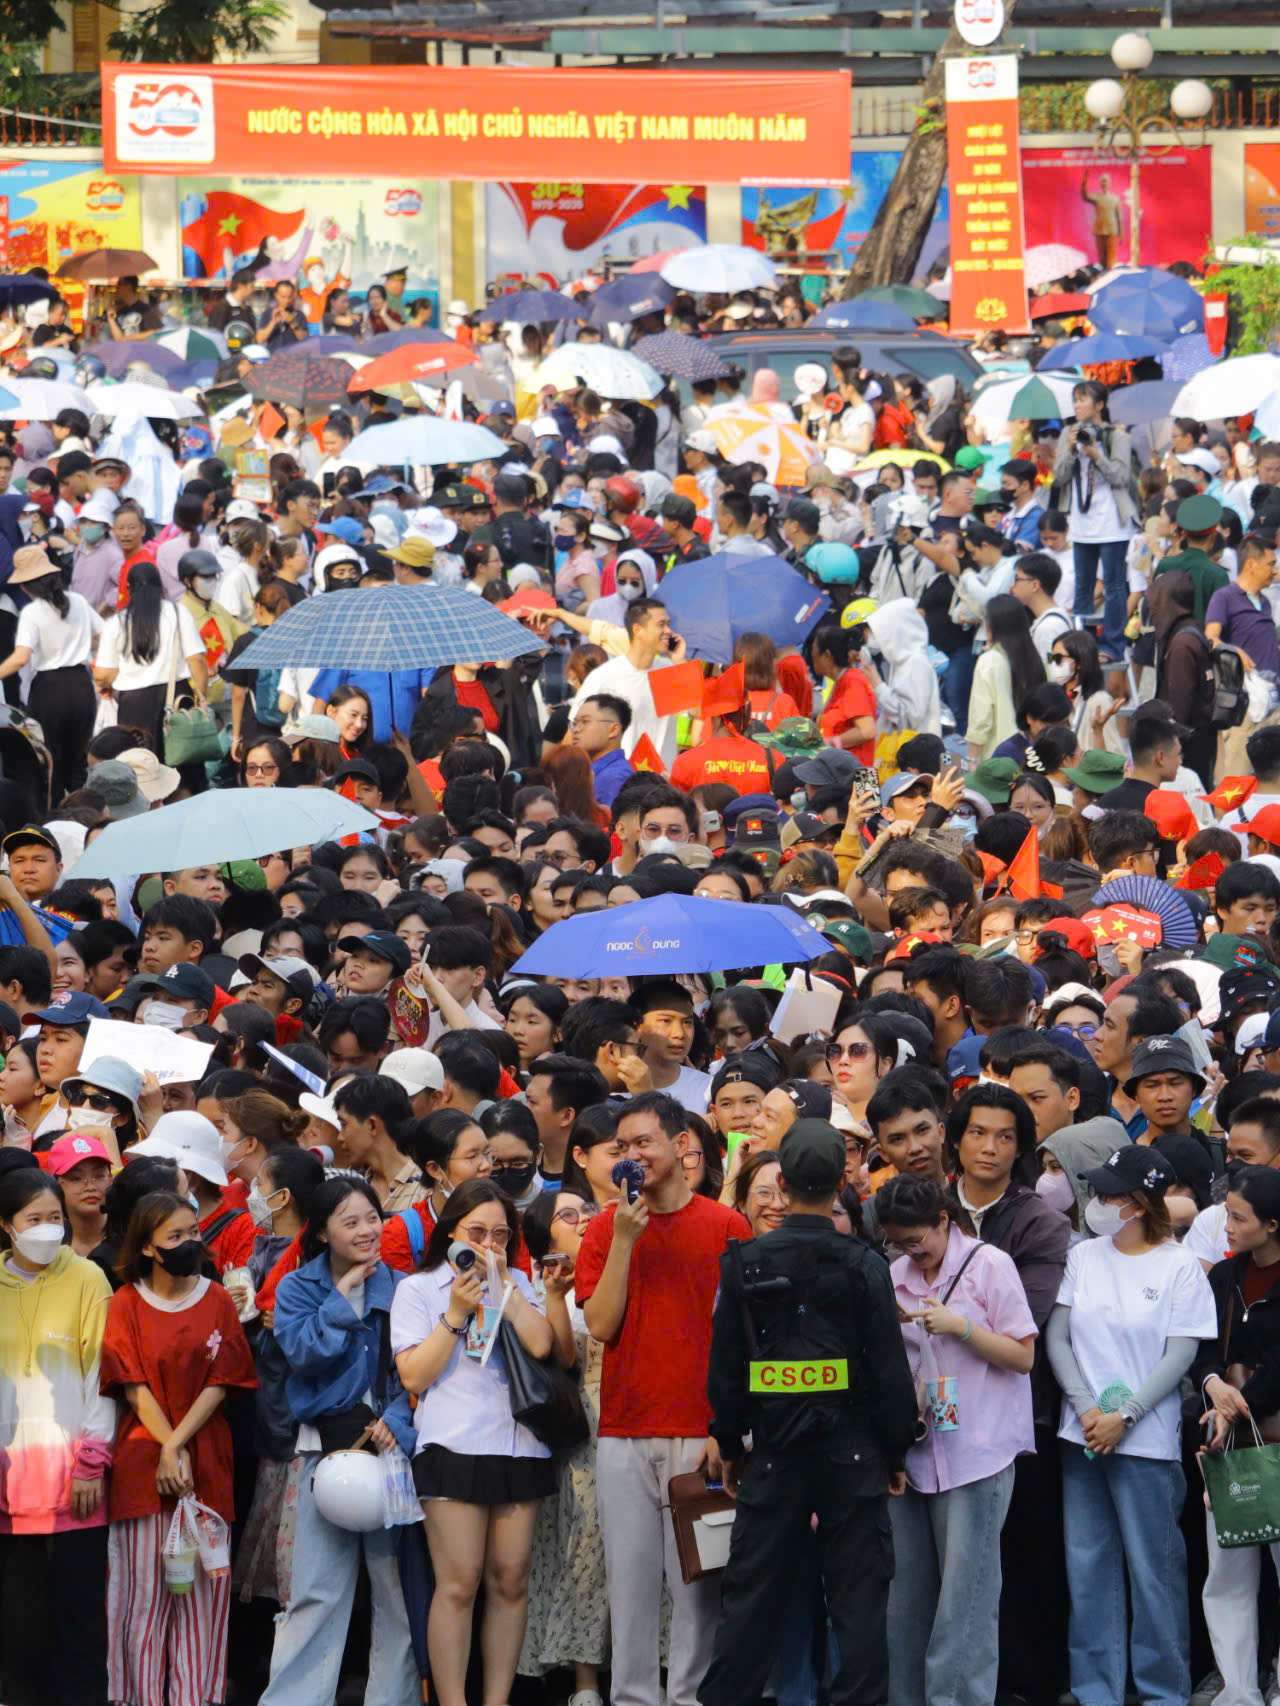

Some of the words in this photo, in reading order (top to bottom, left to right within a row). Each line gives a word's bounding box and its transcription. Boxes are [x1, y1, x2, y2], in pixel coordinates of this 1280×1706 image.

[247, 106, 302, 135] NƯỚC
[307, 107, 363, 140] CỘNG
[366, 107, 409, 136] HÒA
[411, 108, 440, 137] XÃ
[443, 109, 477, 142] HỘI
[482, 106, 523, 138] CHỦ
[527, 110, 590, 139] NGHĨA
[594, 111, 637, 144] VIỆT
[640, 114, 689, 140] NAM
[693, 112, 755, 142] MUÔN
[758, 113, 807, 142] NĂM
[760, 1366, 839, 1387] CSCĐ
